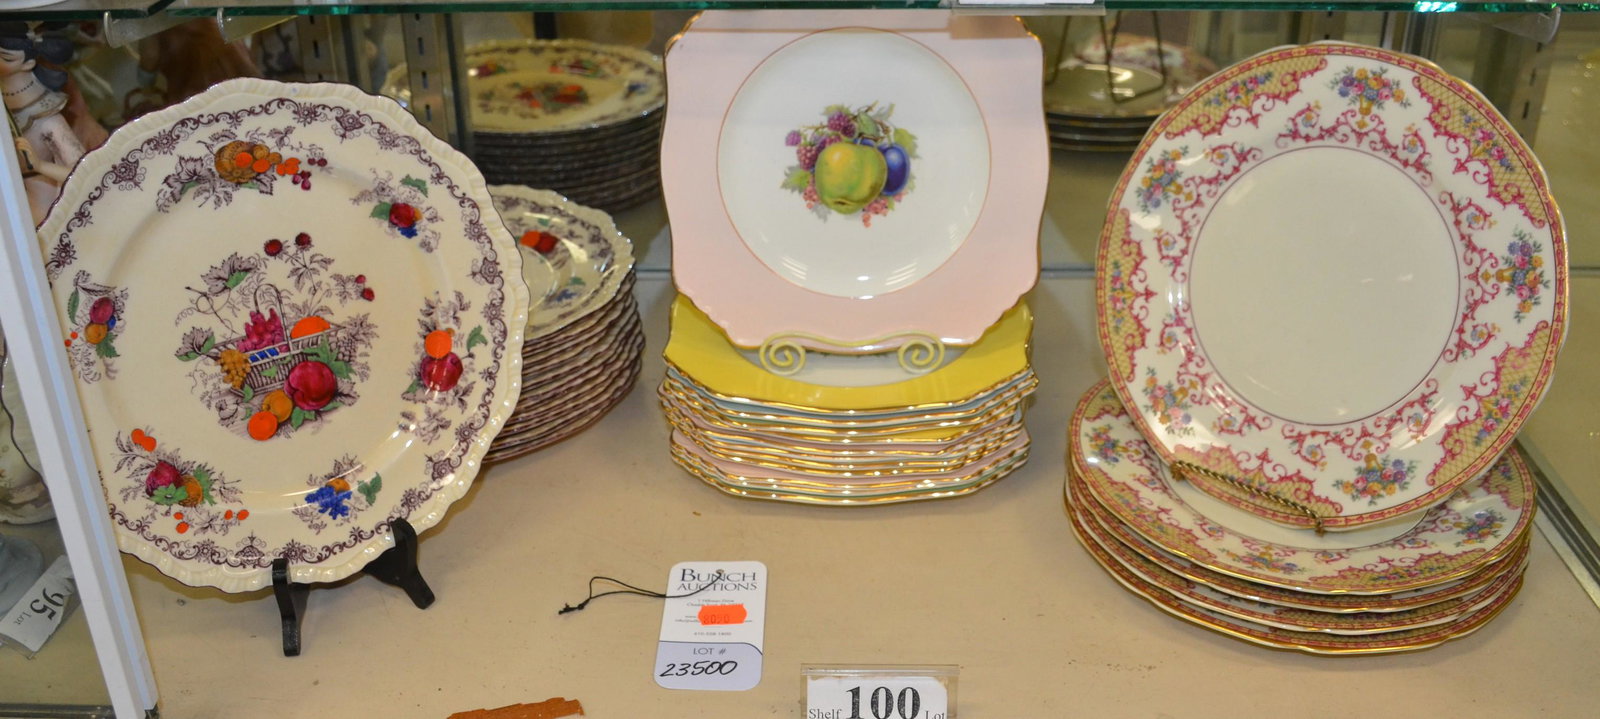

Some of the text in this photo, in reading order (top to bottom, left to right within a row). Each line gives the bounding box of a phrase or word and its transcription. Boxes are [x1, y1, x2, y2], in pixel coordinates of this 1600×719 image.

[681, 568, 757, 583] BUNCH
[678, 582, 757, 591] AUCTIONS
[30, 587, 64, 621] 95
[659, 660, 738, 678] 23500
[808, 708, 843, 719] Shelf
[845, 686, 921, 719] 100
